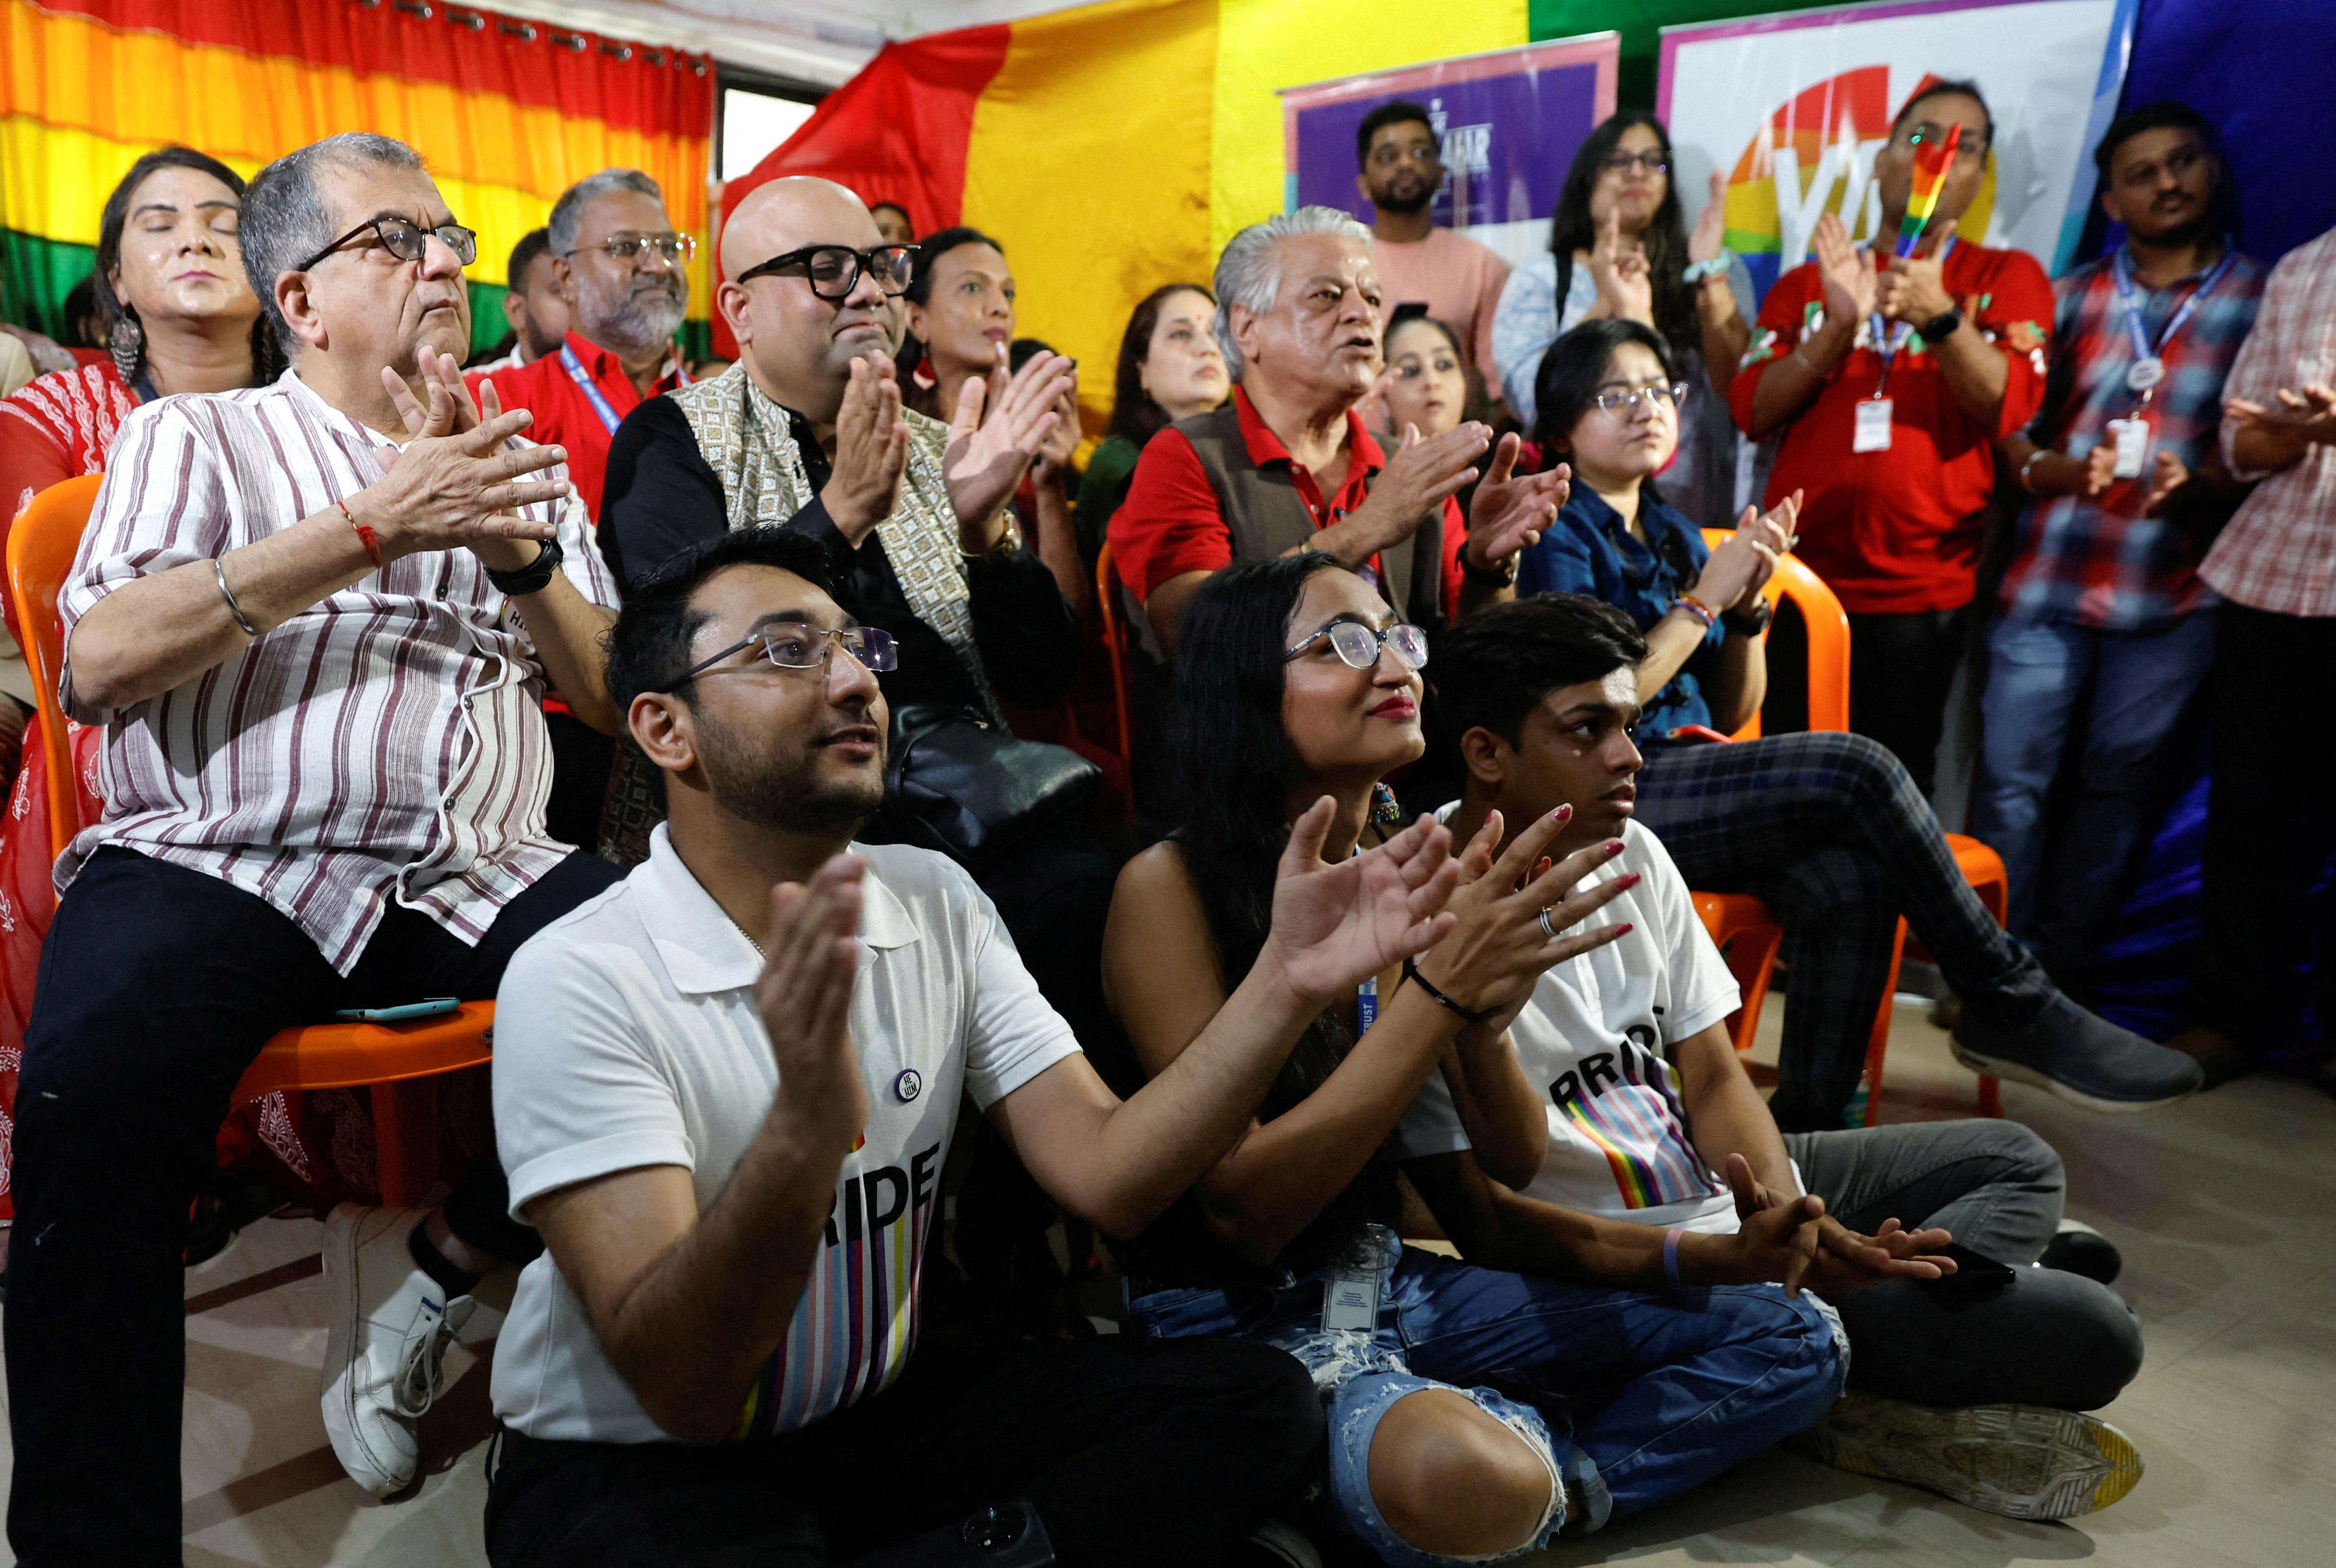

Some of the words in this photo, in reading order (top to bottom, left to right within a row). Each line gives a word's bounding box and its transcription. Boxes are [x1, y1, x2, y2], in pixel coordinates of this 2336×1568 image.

[903, 1073, 913, 1086] HE
[904, 1083, 917, 1098] HIM
[824, 1141, 940, 1248] IDE
